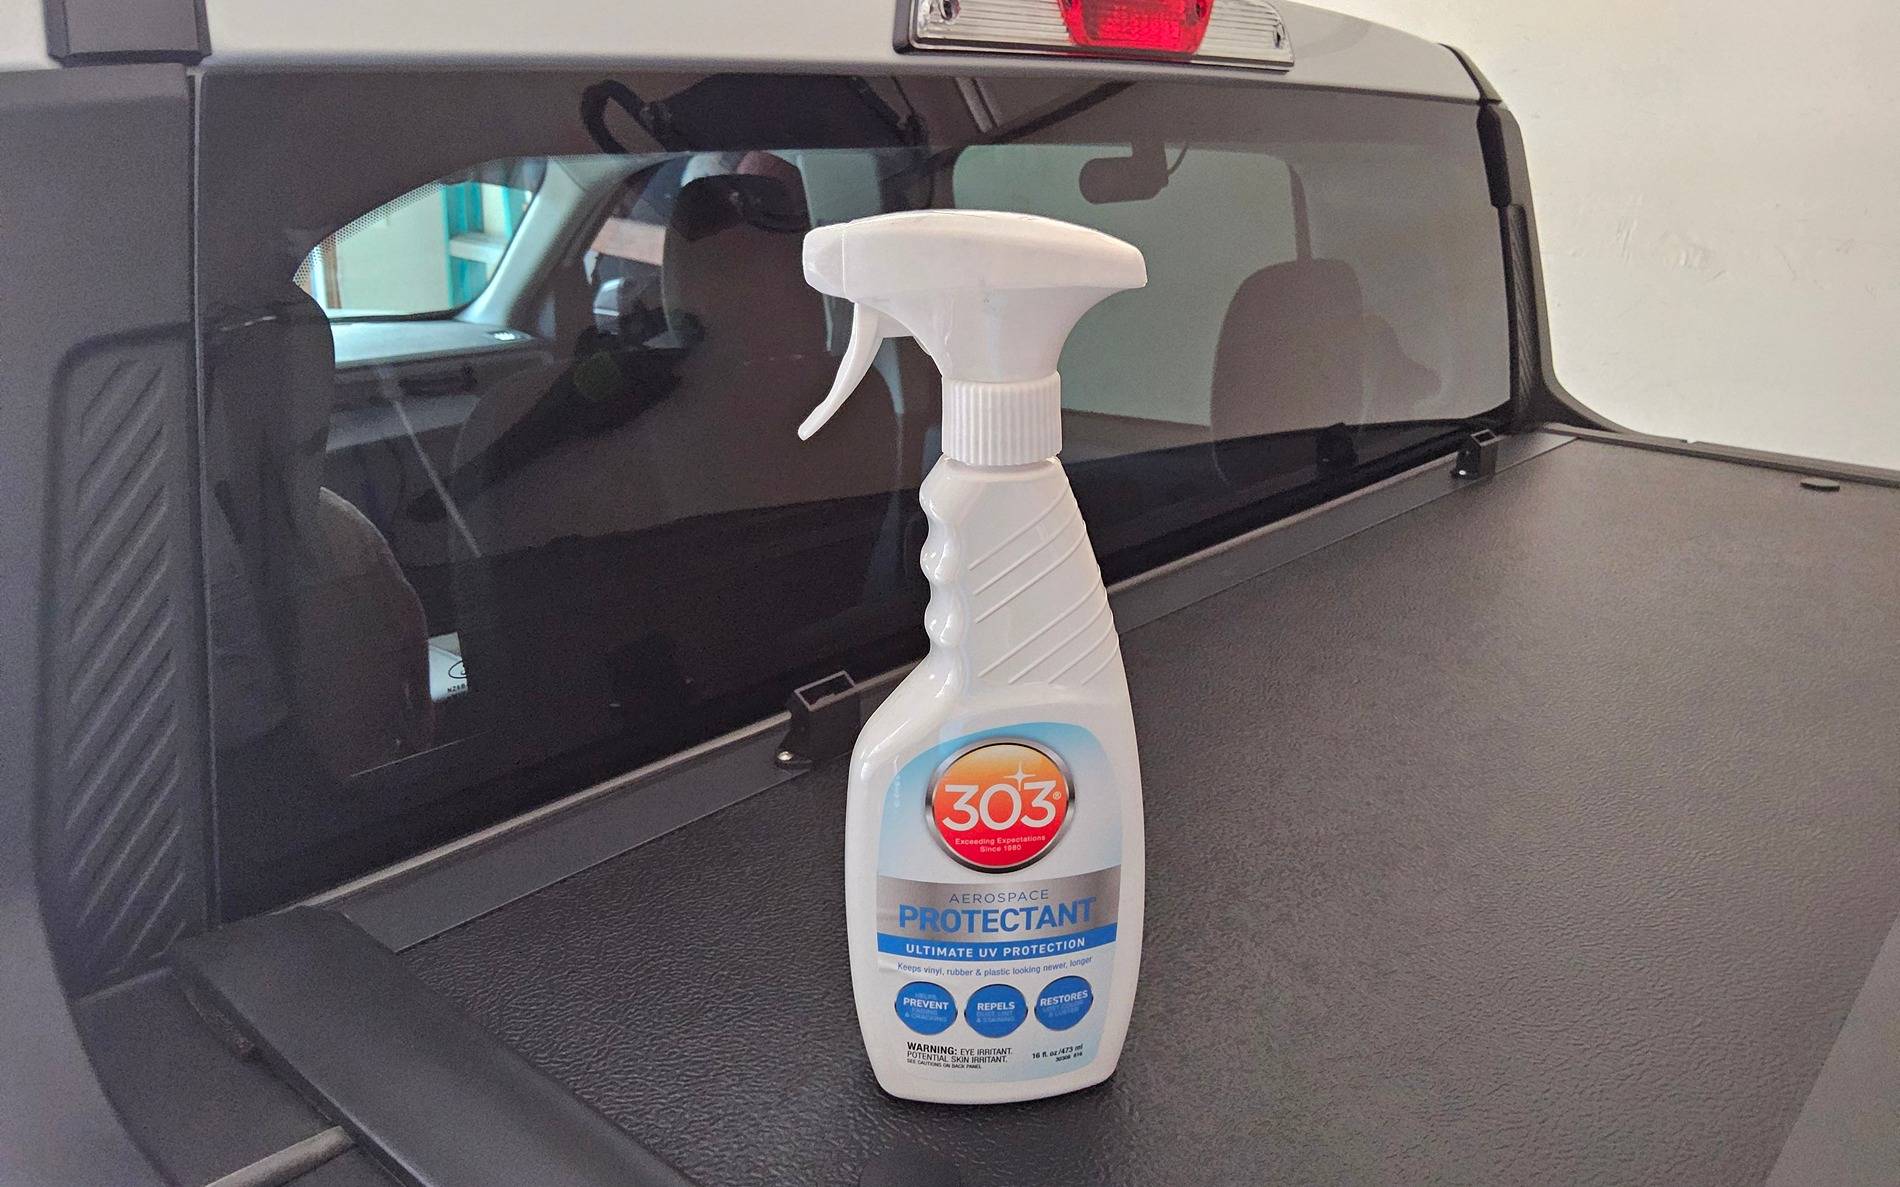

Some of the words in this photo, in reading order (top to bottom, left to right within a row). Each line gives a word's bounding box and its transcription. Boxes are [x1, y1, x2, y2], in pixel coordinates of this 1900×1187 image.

[955, 838, 995, 846] Exceeding
[997, 835, 1046, 845] Expectations
[980, 845, 1001, 853] Since
[1003, 844, 1022, 852] 1980
[949, 889, 1049, 904] AEROSPACE
[899, 896, 1097, 934] PROTECTANT
[906, 943, 973, 958] ULTIMATE
[979, 948, 998, 958] UV
[1003, 937, 1086, 957] PROTECTION
[897, 962, 922, 973] Keeps
[923, 966, 945, 976] vinyl,
[946, 967, 973, 976] rubber
[975, 968, 982, 976] &
[984, 967, 1010, 977] plastic
[1012, 965, 1041, 976] looking
[1043, 962, 1068, 973] newer,
[1069, 956, 1092, 968] longer
[903, 997, 949, 1011] PREVENT
[1040, 990, 1089, 1007] RESTORES
[977, 1002, 1016, 1011] REPELS
[907, 1041, 958, 1056] WARNING:
[960, 1048, 975, 1056] EYE
[977, 1047, 1013, 1056] IRRITANT.
[1032, 1052, 1041, 1060] 16
[1075, 1043, 1084, 1052] ml
[907, 1050, 949, 1063] POTENTIAL
[951, 1055, 970, 1063] SKIN
[971, 1055, 1008, 1064] IRRITANT.
[917, 1060, 942, 1068] CAUTIONS
